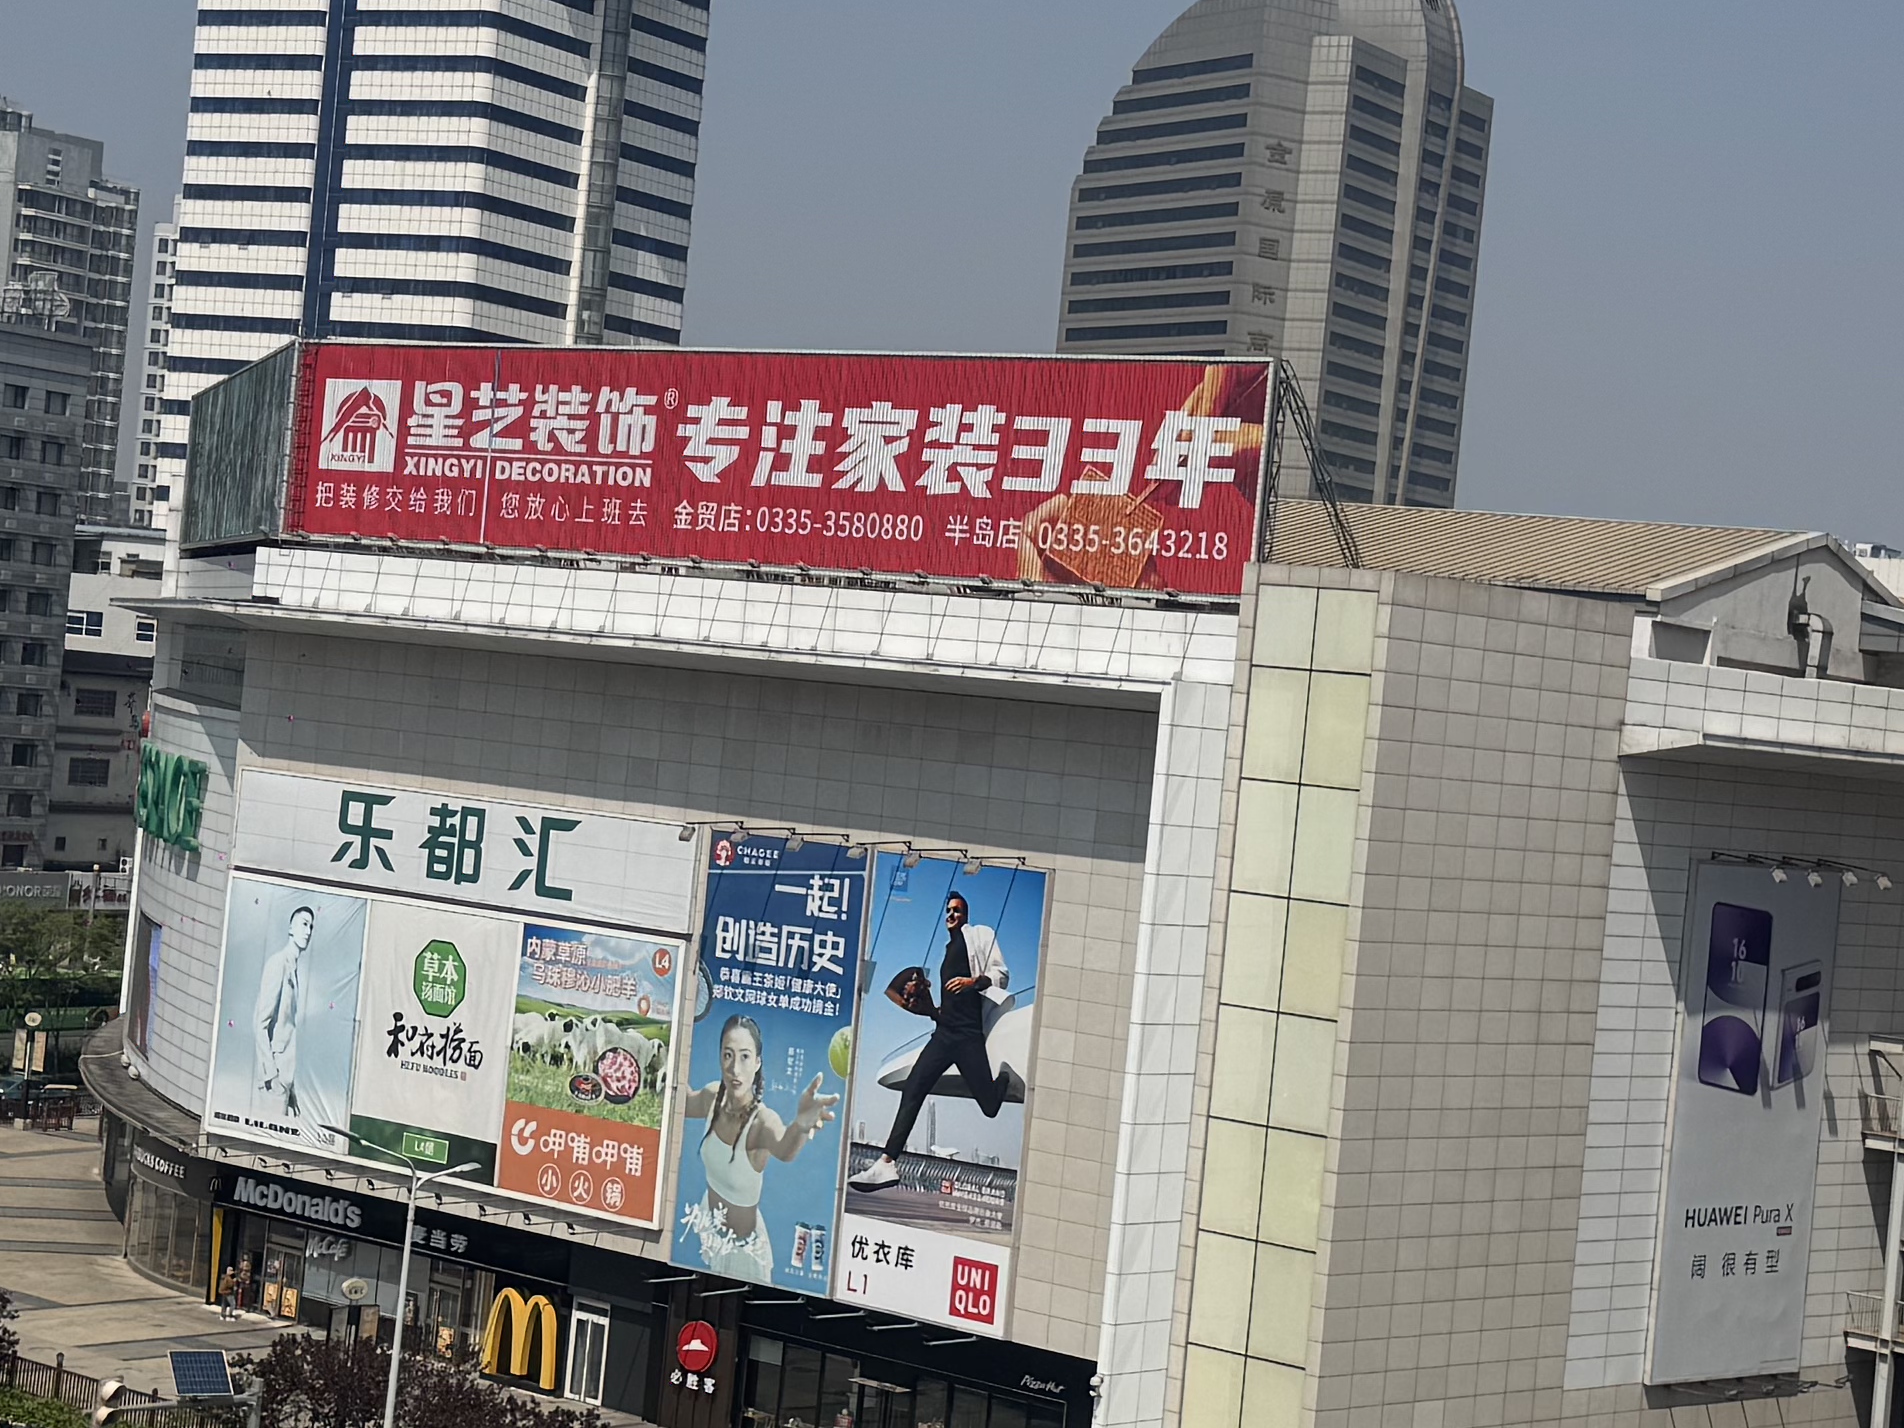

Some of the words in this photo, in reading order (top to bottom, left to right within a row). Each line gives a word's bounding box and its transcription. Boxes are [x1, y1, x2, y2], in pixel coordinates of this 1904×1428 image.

[406, 380, 659, 457] 星艺装饰
[404, 456, 484, 481] XINGYI
[494, 460, 653, 488] DECORATION
[314, 481, 479, 519] 把装修交给我们
[500, 491, 650, 529] 您放心上班去
[330, 788, 583, 902] 乐都汇
[736, 845, 780, 860] CHAGEE
[526, 935, 589, 966] 内蒙草原
[654, 951, 671, 971] L4
[714, 915, 846, 976] 创造历史
[1731, 937, 1747, 961] 16
[421, 950, 459, 985] 草本
[385, 1011, 485, 1070] 和府捞面
[539, 1124, 645, 1179] 呷哺呷哺
[154, 1155, 186, 1180] COFFEE
[233, 1175, 363, 1229] McDonald's
[540, 1166, 625, 1210] 小火锅
[1684, 1204, 1749, 1229] HUAWEI
[1752, 1203, 1781, 1225] Pura
[1784, 1202, 1795, 1223] X
[850, 1233, 916, 1271] 优衣库
[1721, 1248, 1781, 1278] 很有型
[846, 1270, 869, 1296] L1
[956, 1263, 990, 1292] UNI
[954, 1288, 992, 1316] QLO
[669, 1367, 717, 1396] 必胜客
